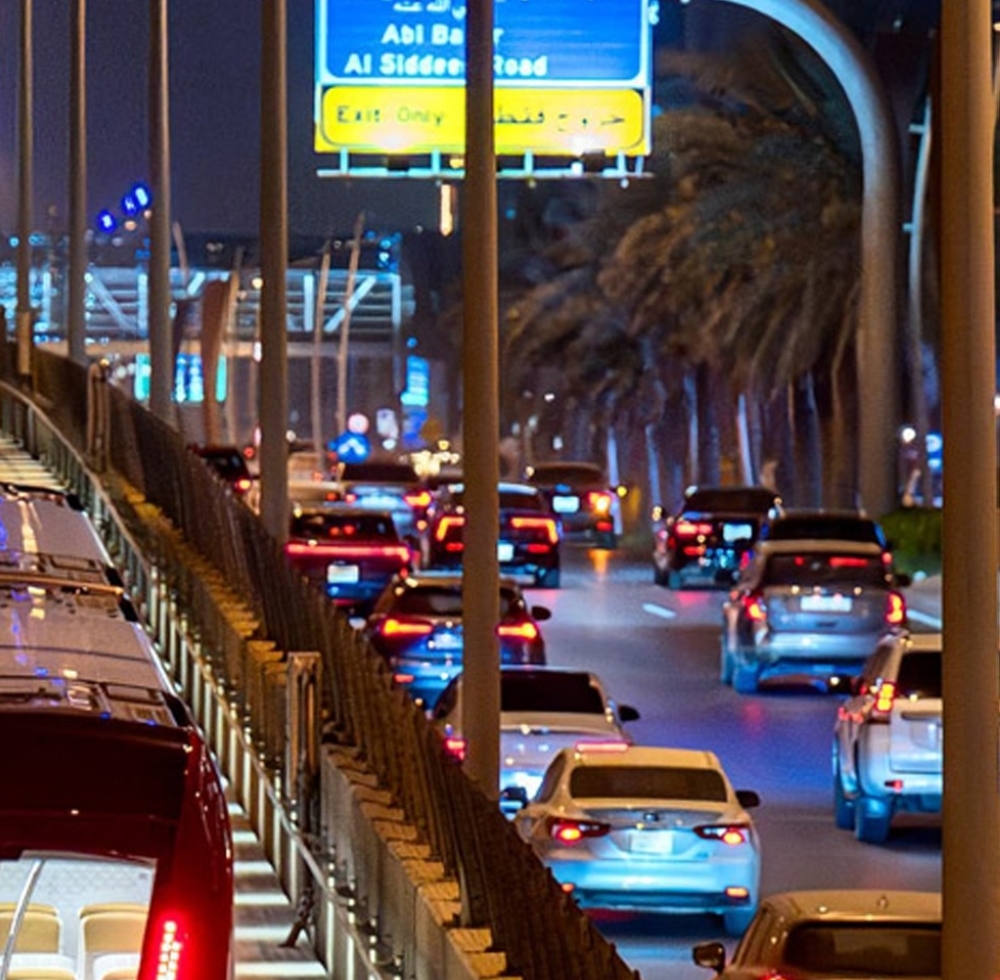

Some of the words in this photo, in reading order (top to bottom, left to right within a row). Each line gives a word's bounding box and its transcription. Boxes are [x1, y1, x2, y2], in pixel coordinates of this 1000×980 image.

[381, 23, 424, 45] Abi
[344, 53, 372, 75] Al
[379, 53, 466, 76] Siddee
[336, 105, 381, 124] Exit
[396, 106, 446, 127] Only
